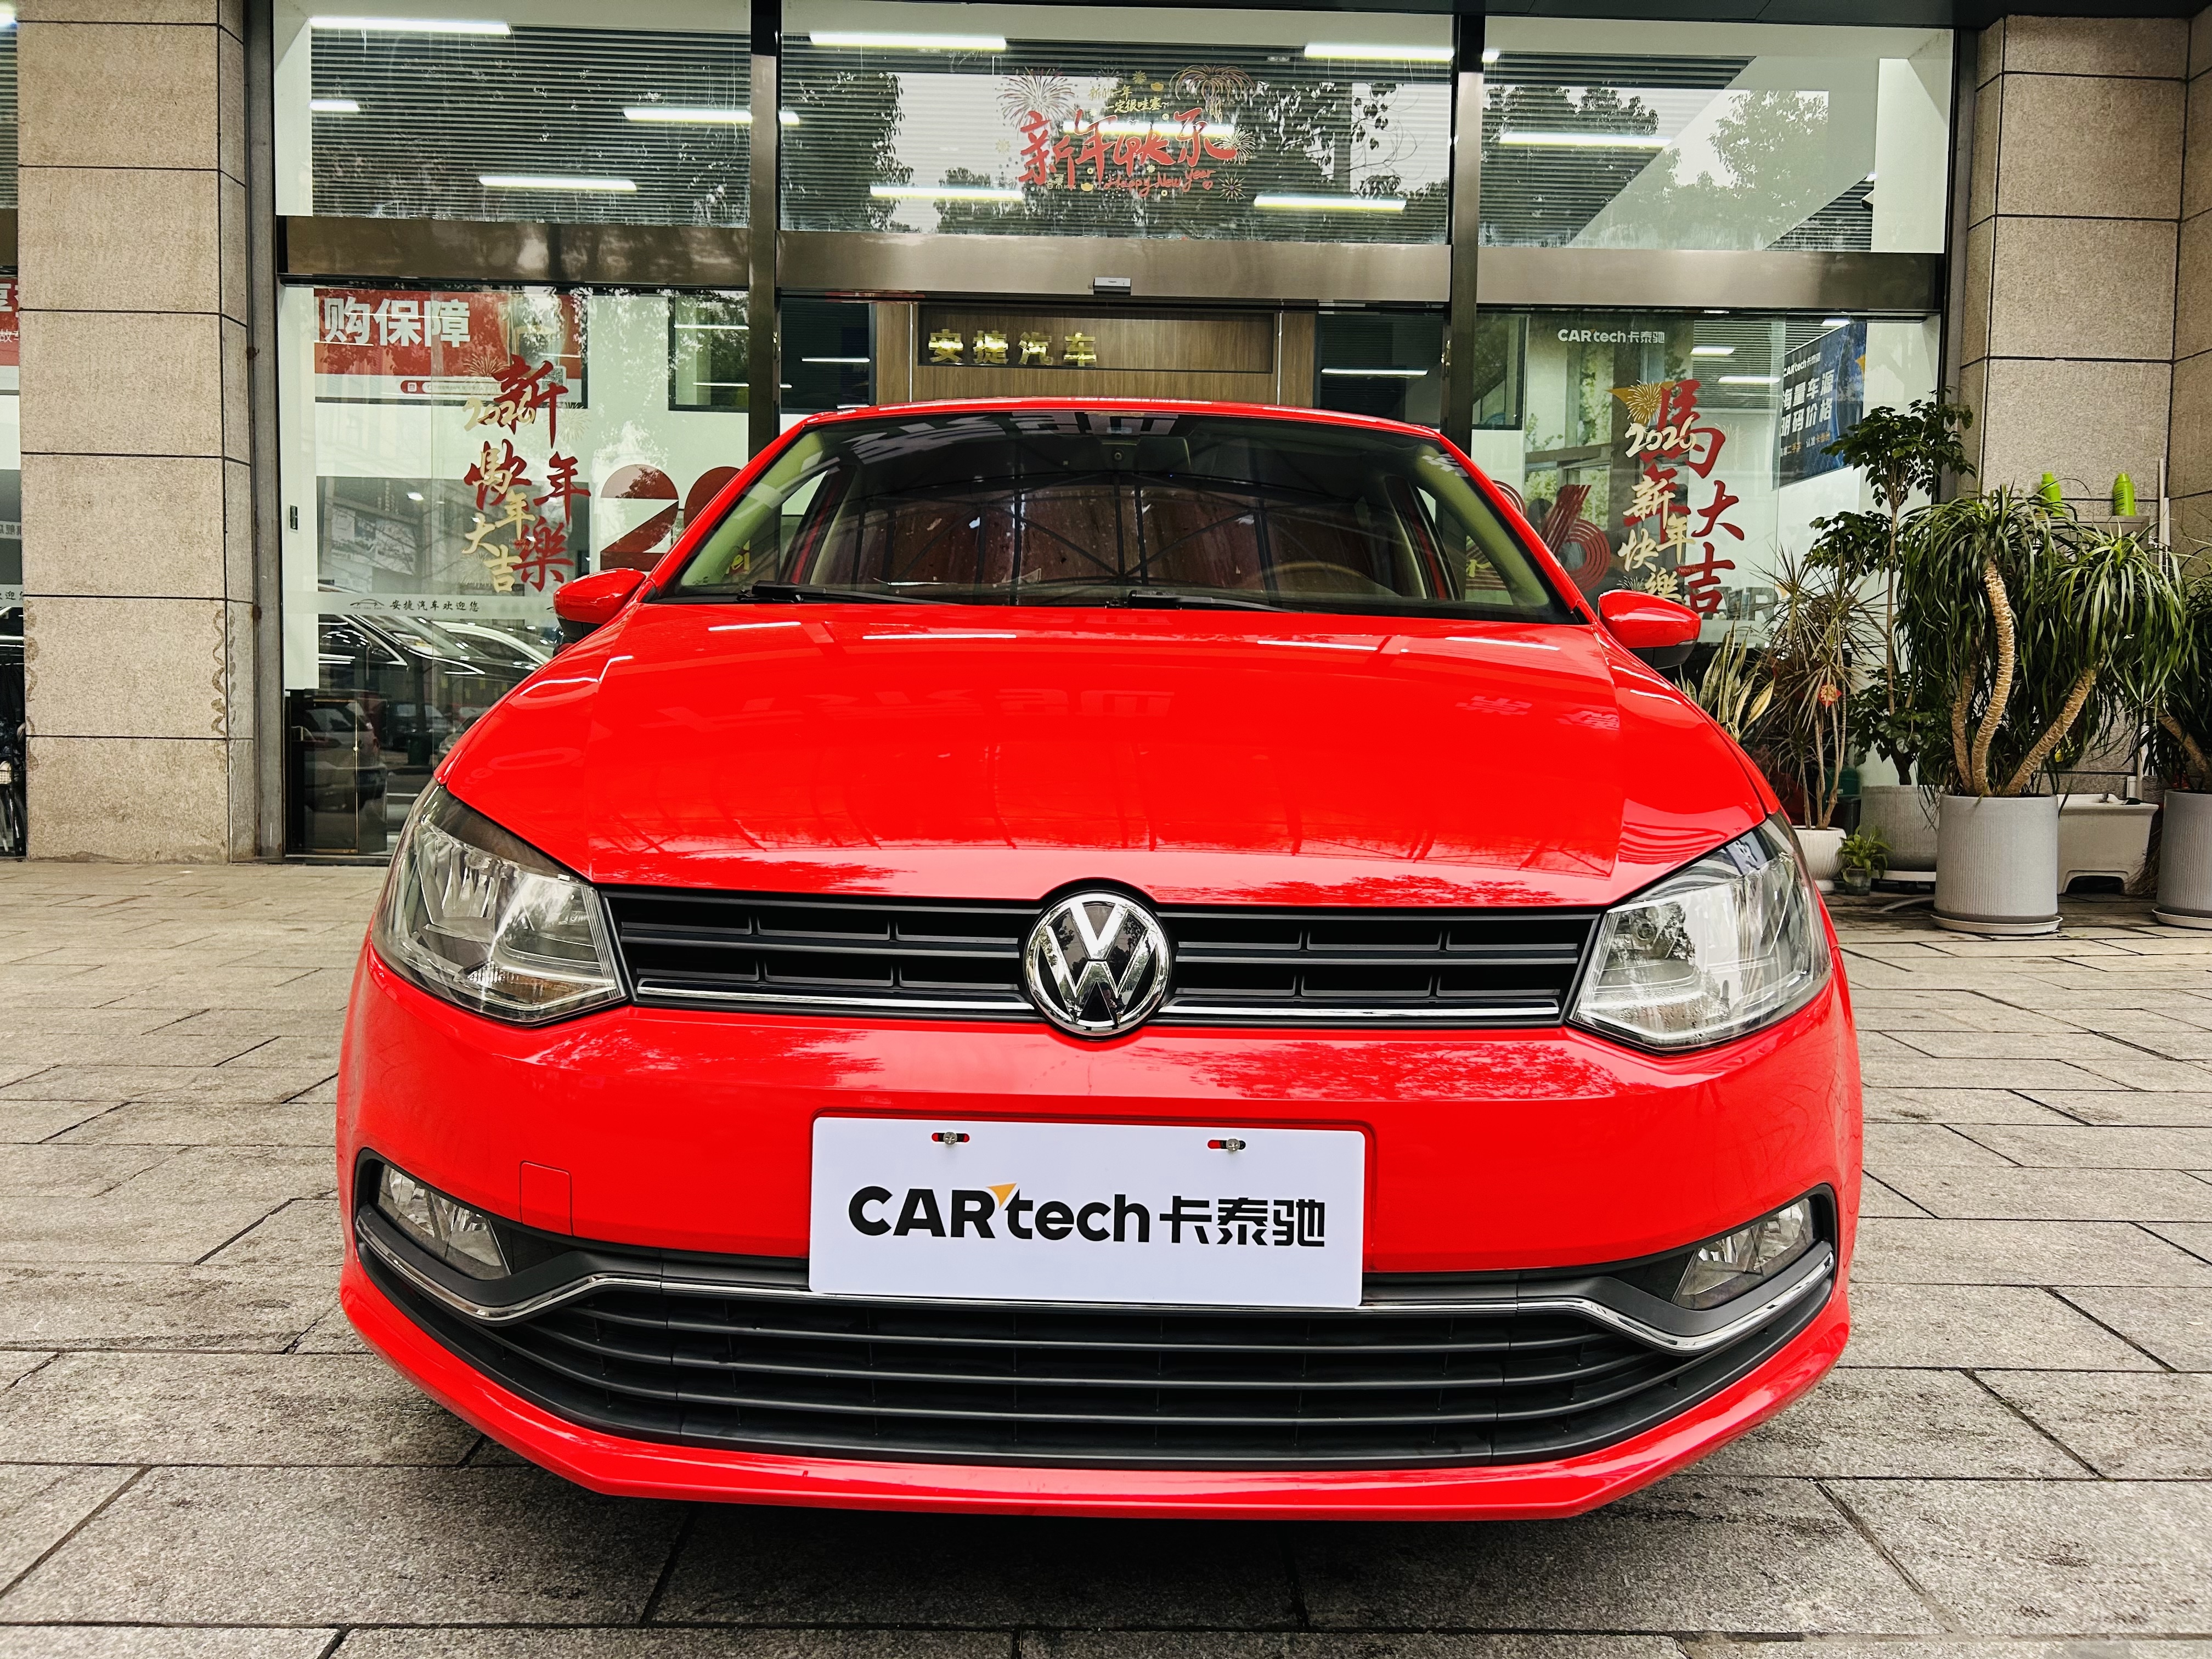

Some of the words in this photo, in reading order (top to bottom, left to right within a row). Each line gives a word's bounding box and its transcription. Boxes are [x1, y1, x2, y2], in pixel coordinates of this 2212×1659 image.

[314, 296, 470, 347] 购保障
[1558, 329, 1626, 343] CARtech
[1627, 331, 1665, 343] 卡泰驰
[928, 329, 1097, 367] 安捷汽车
[1782, 369, 1835, 411] 海量车源
[1624, 414, 1697, 458] 2026
[1779, 398, 1833, 437] 明码价格
[390, 599, 480, 613] 安捷汽车欢迎您
[848, 1183, 1150, 1243] CARtech
[1159, 1195, 1325, 1248] 卡泰驰
